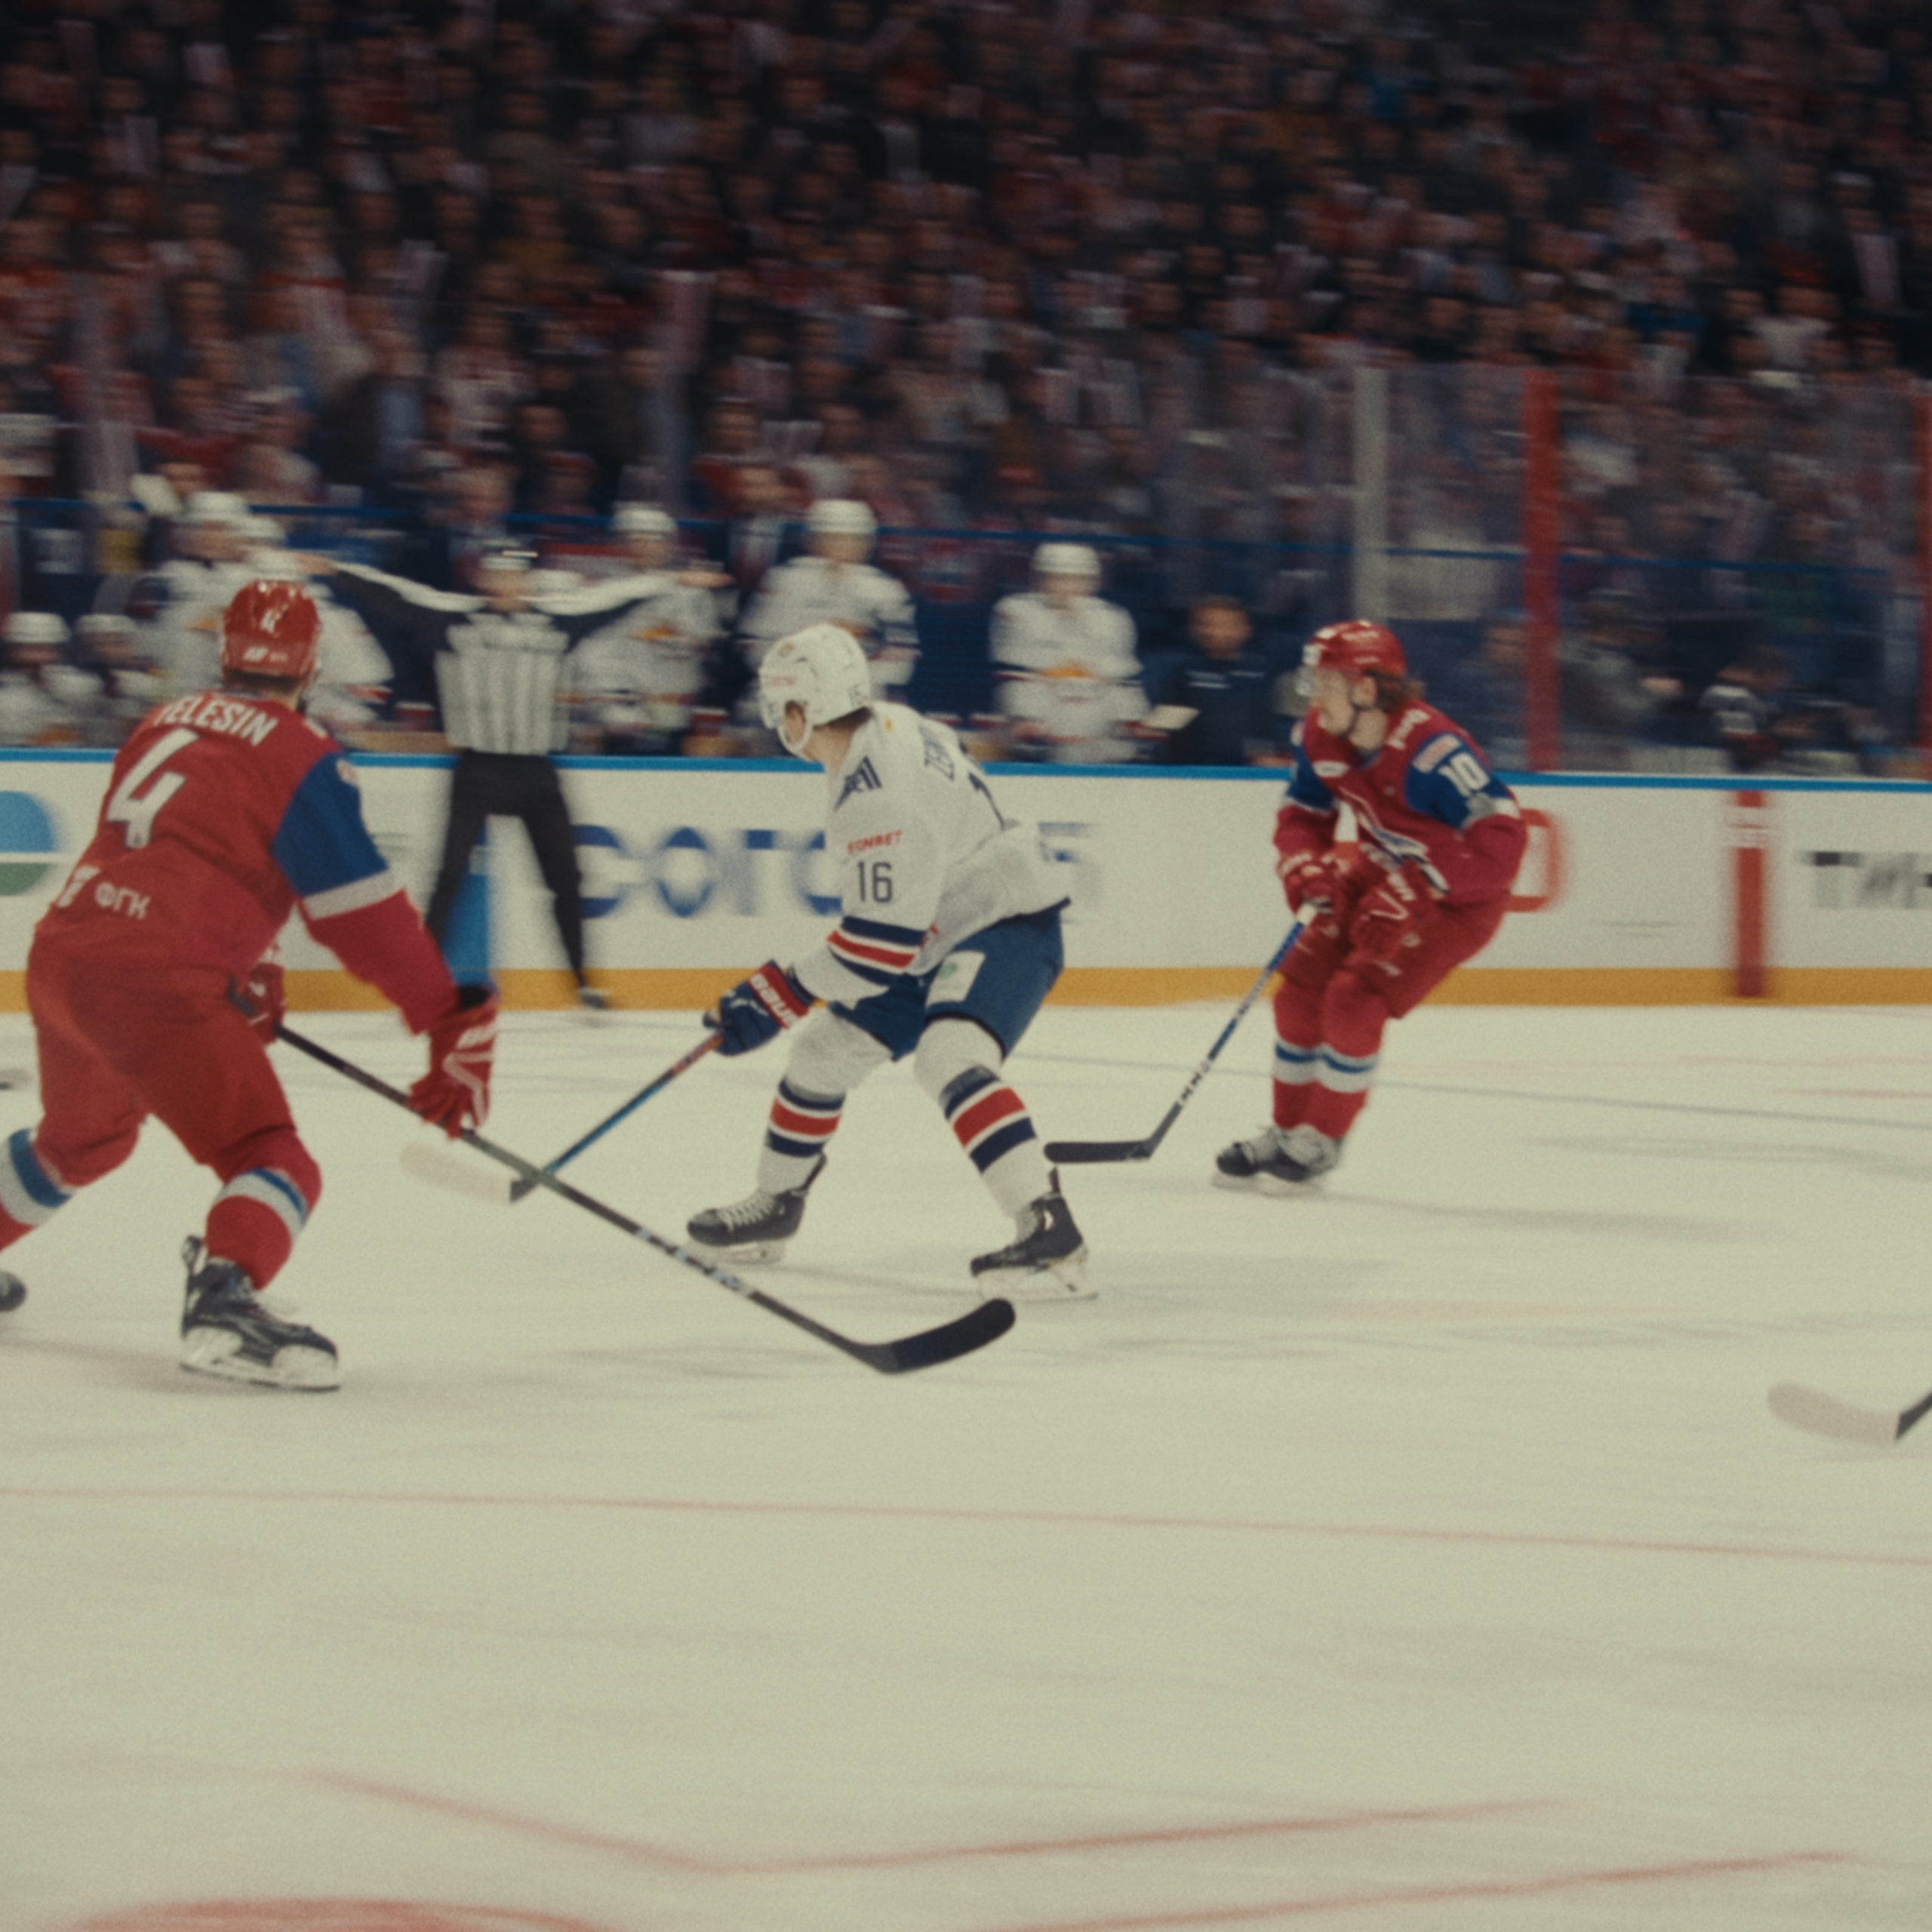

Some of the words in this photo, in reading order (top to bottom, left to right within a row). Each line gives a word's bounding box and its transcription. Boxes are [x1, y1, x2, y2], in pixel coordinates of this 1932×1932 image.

[106, 726, 201, 850] 4
[1437, 752, 1491, 797] 10
[94, 881, 151, 921] ФГК
[857, 860, 893, 903] 16
